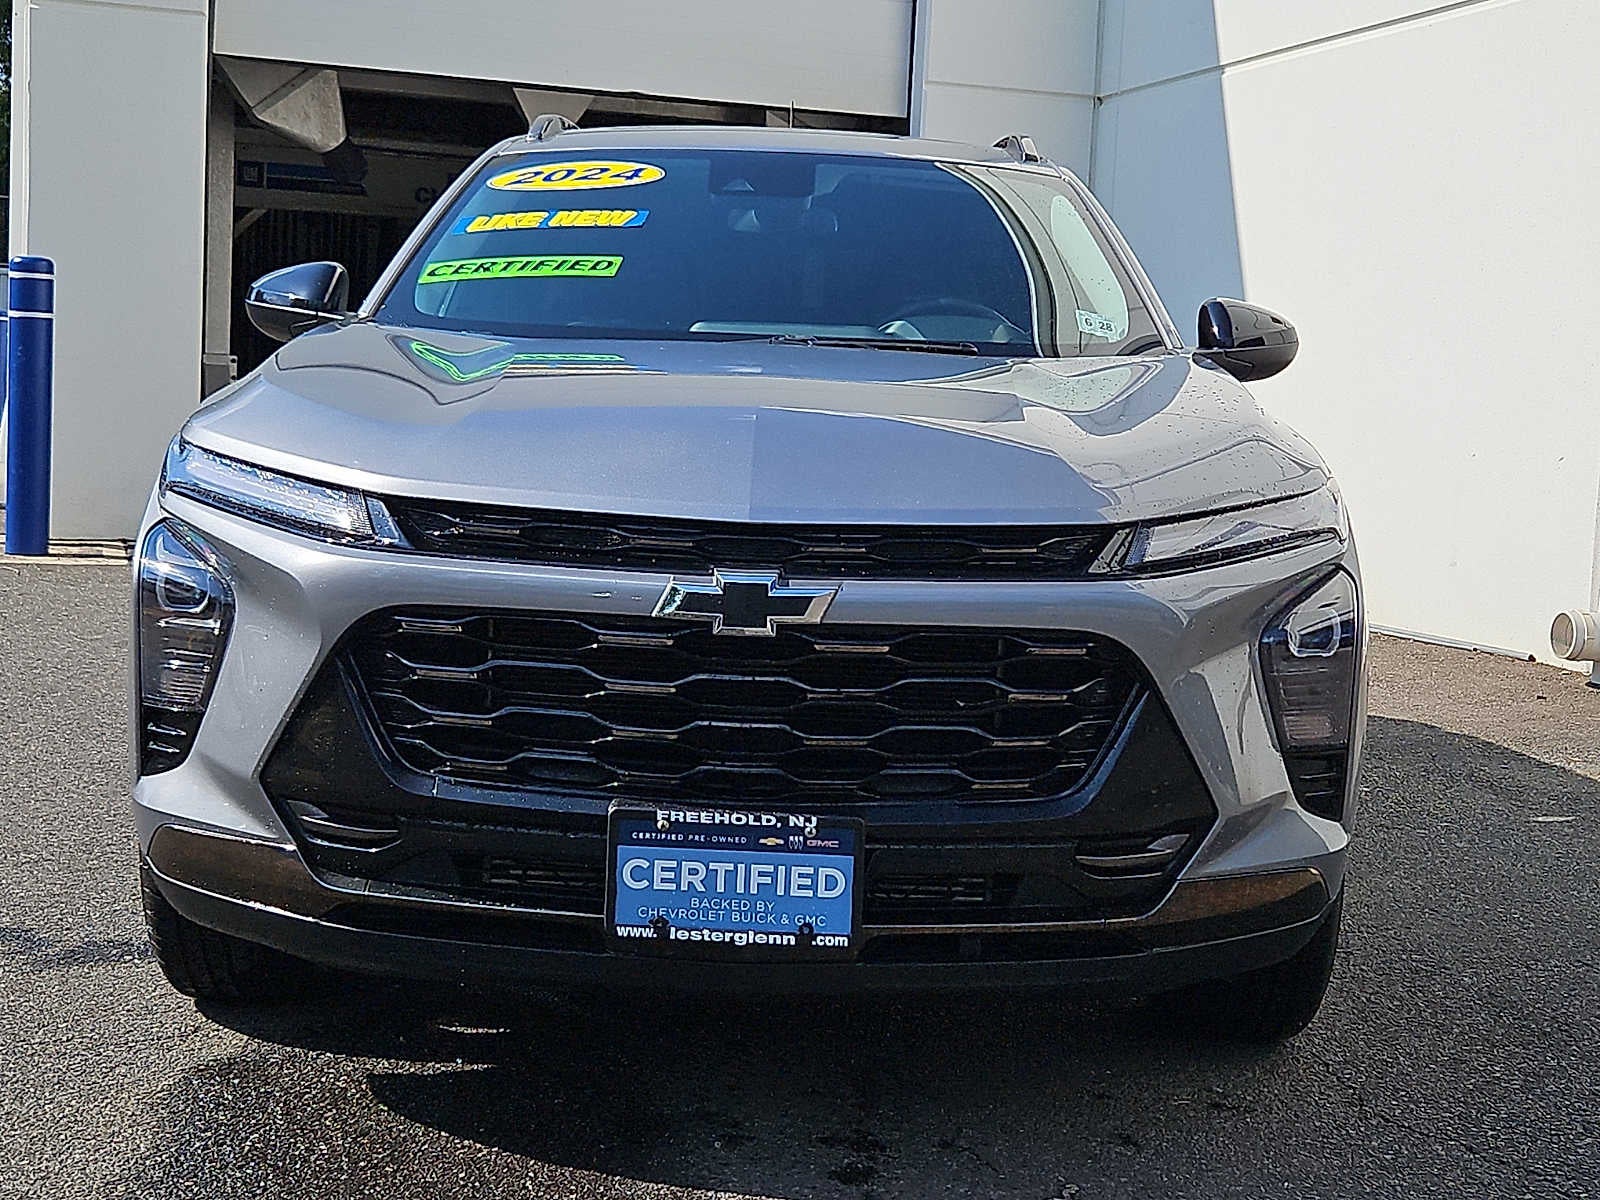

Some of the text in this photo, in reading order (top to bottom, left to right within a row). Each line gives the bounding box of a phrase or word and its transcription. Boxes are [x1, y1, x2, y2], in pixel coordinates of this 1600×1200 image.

[506, 167, 647, 185] 2024
[466, 210, 637, 232] LIKE NEW
[427, 259, 614, 277] CERTIFIED
[1084, 317, 1093, 327] 6
[656, 809, 817, 828] FREEHOLD, NJ
[631, 831, 748, 845] CERTIFIED PRE-OWNED
[806, 838, 840, 848] GMC
[622, 858, 846, 898] CERTIFIED
[690, 897, 775, 912] BACKED BY
[637, 906, 828, 927] CHEVROLET BUICK & GMC
[616, 925, 849, 948] www. lesterglenn .com
